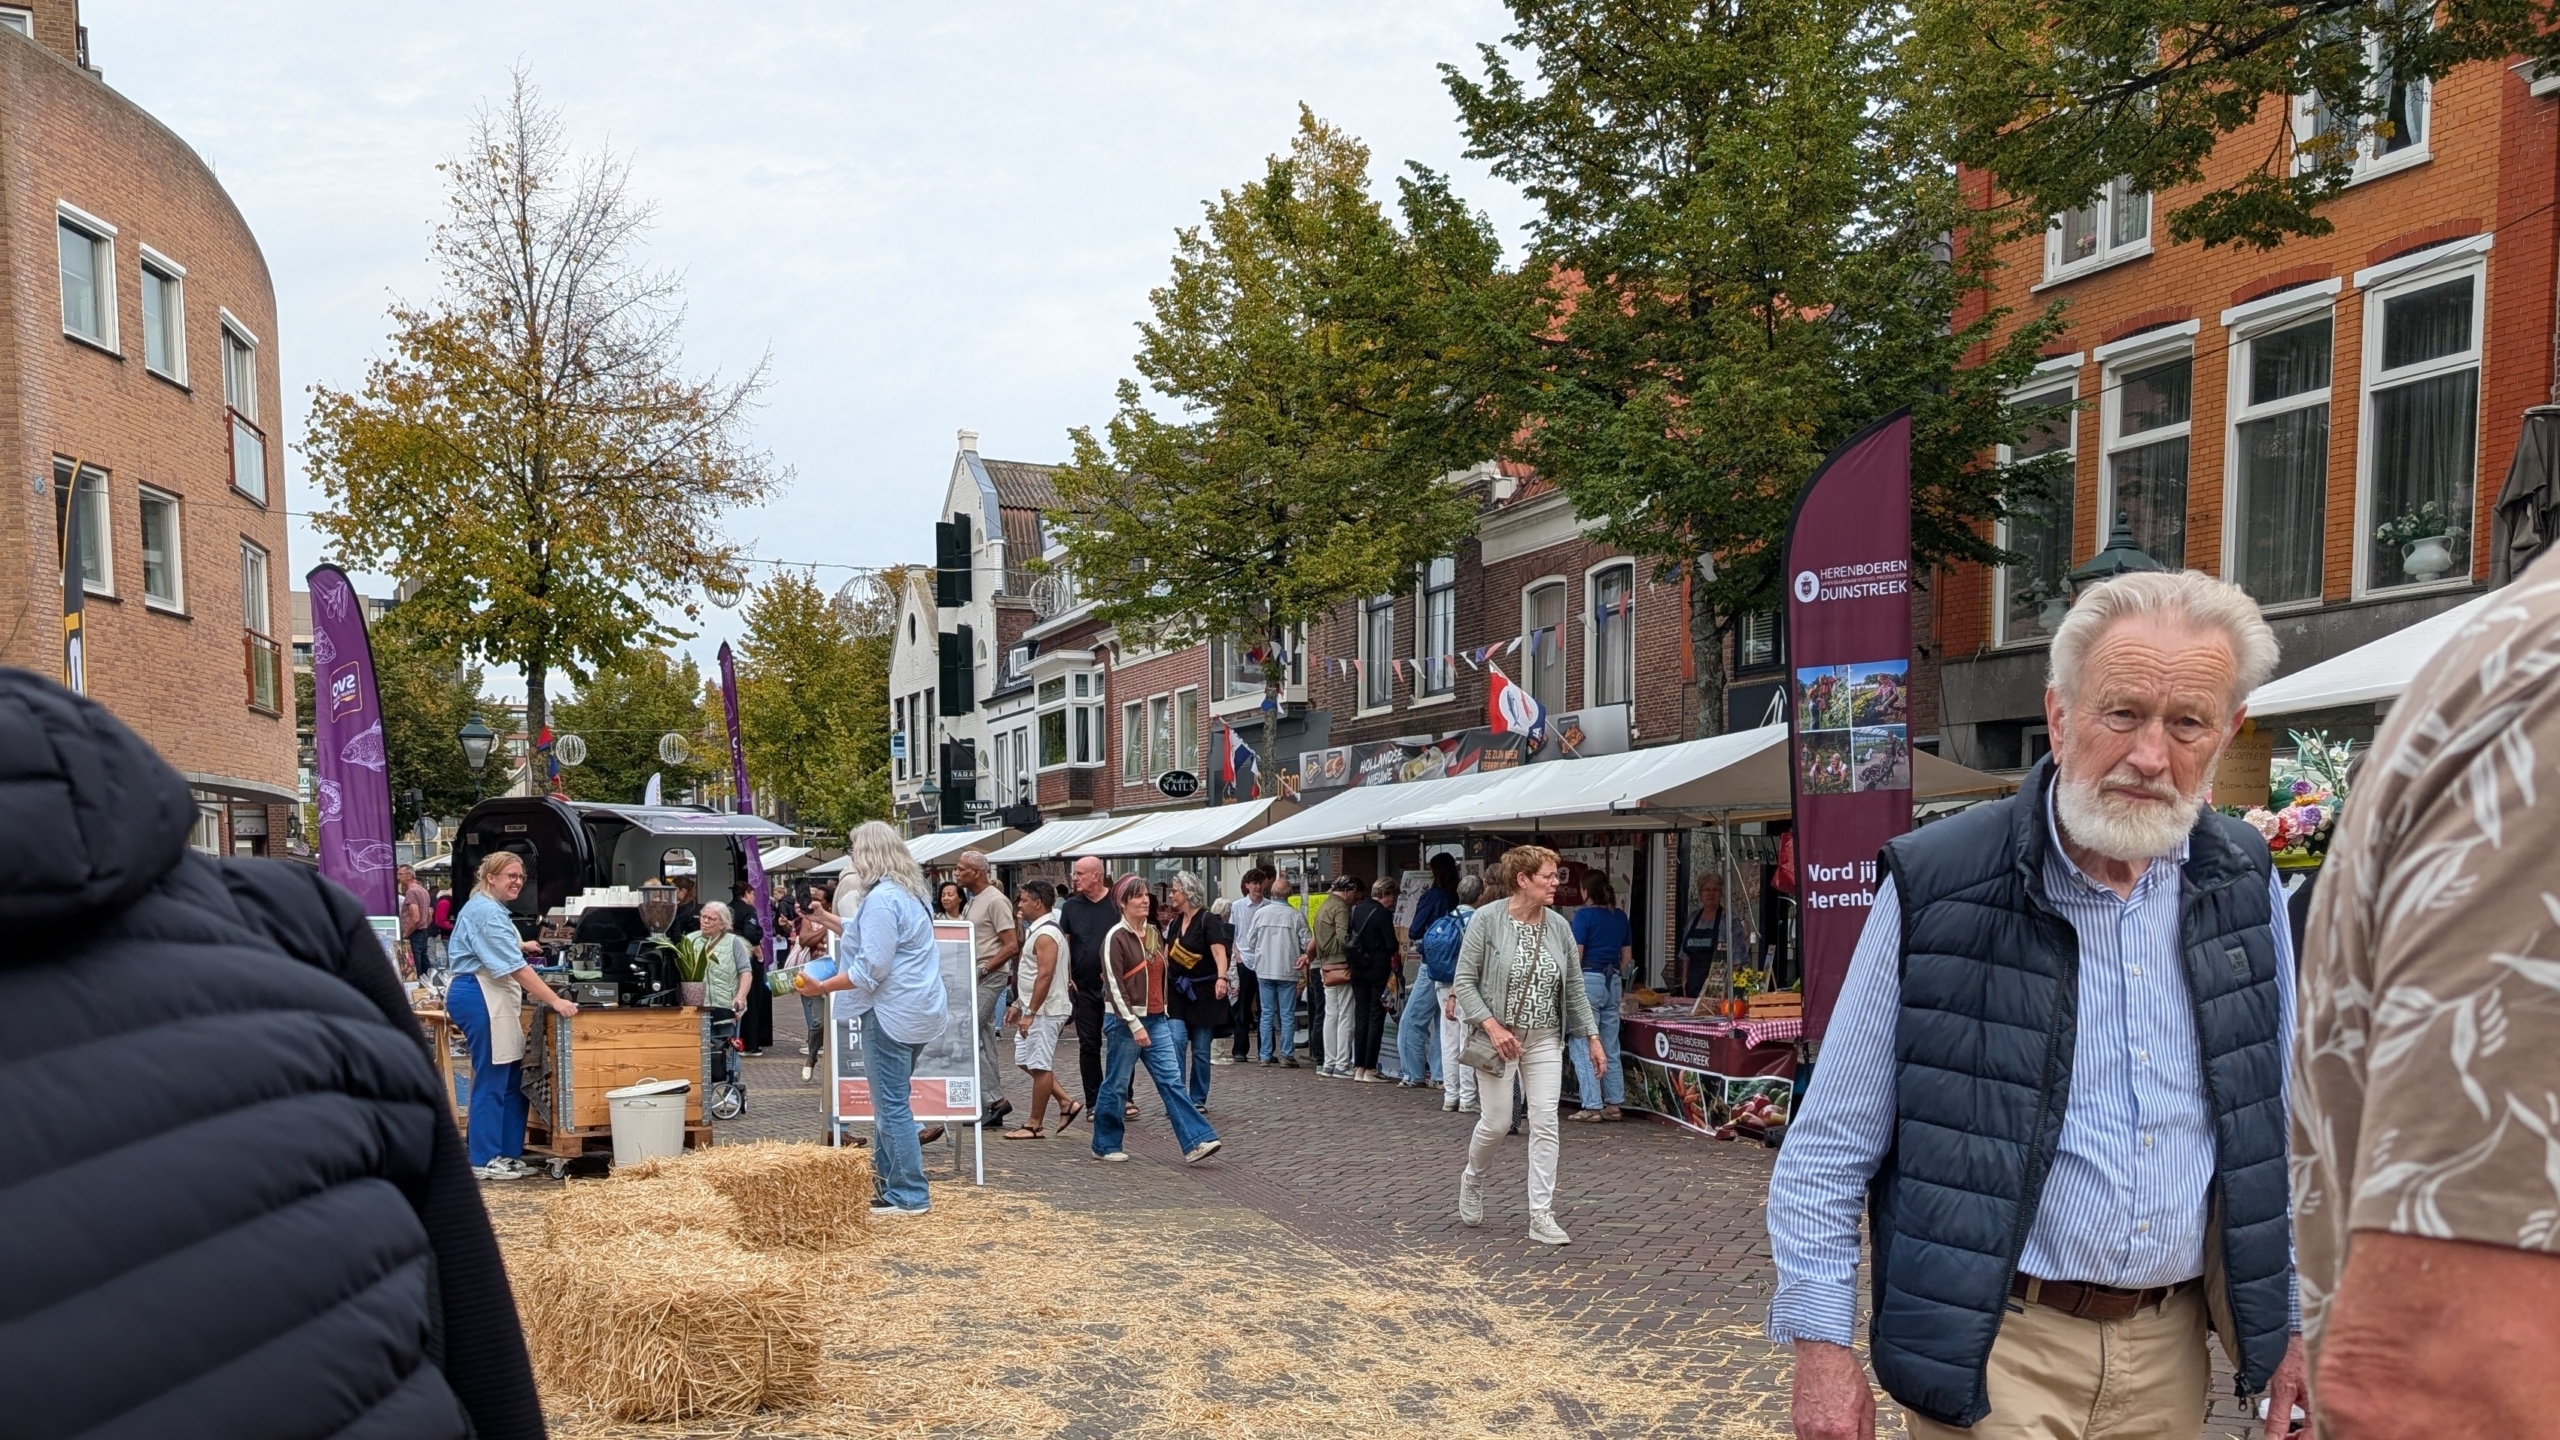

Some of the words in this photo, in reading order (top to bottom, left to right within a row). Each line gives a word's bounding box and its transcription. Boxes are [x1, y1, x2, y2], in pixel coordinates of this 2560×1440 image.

[1820, 560, 1907, 579] HERENBOEREN
[1821, 580, 1908, 601] DUINSTREEK
[1360, 748, 1403, 774] HOLLANDSE
[1366, 767, 1393, 786] NIEUWE
[1163, 783, 1196, 791] NAILS
[965, 802, 989, 810] YARA
[1807, 862, 1853, 882] Word
[1859, 861, 1877, 883] jij
[1667, 1033, 1710, 1050] HERENBOEREN
[1669, 1049, 1710, 1068] DUINSTREEK
